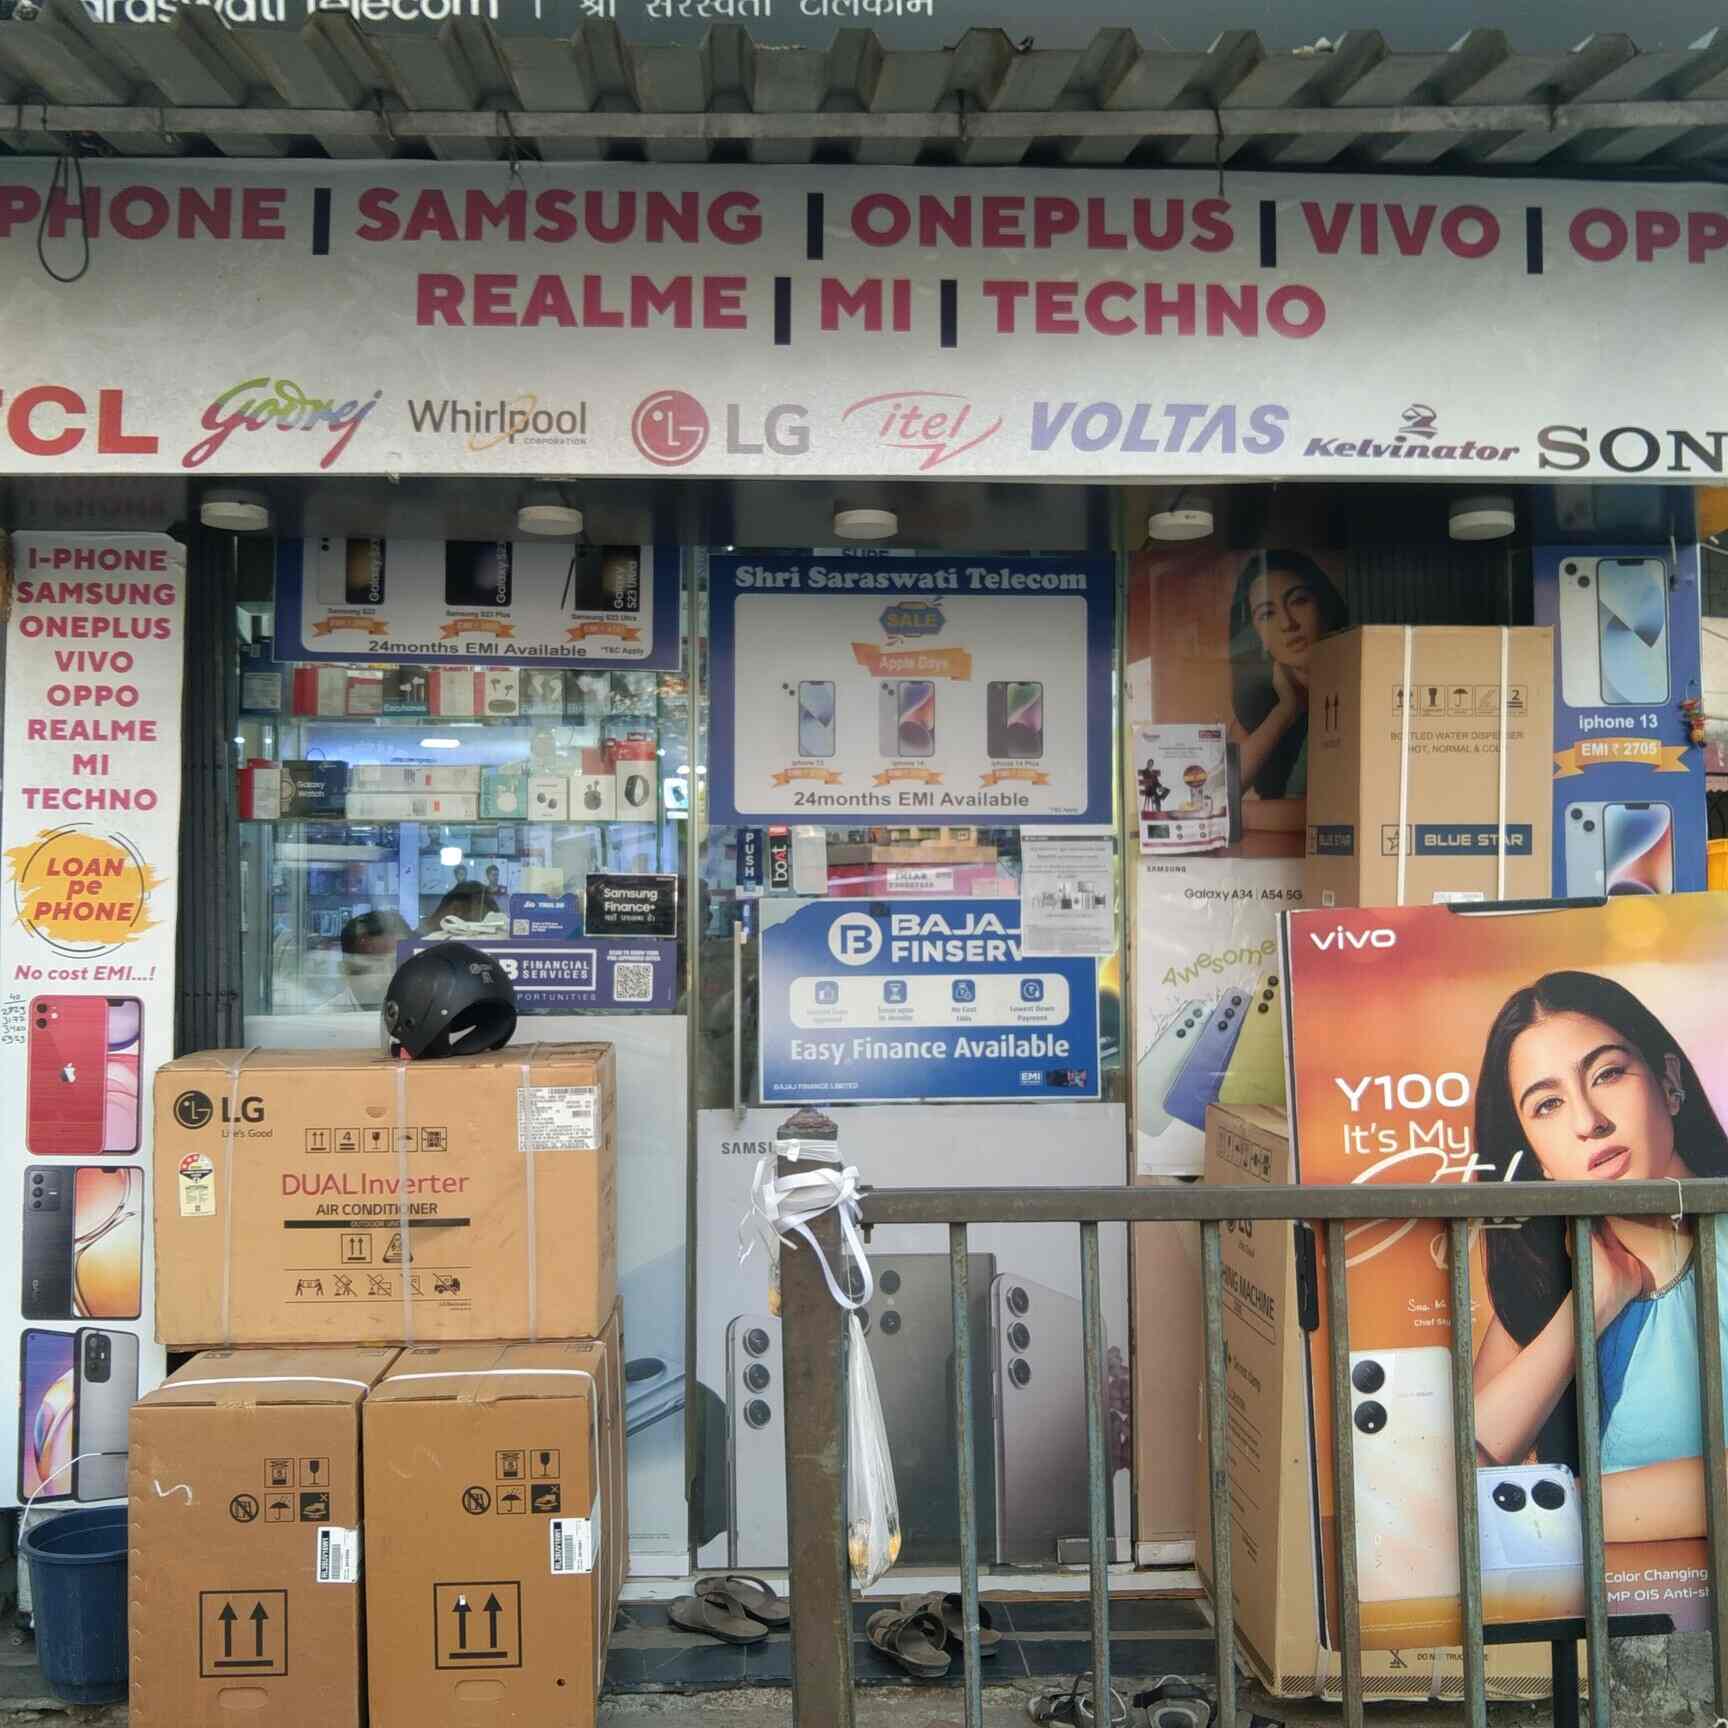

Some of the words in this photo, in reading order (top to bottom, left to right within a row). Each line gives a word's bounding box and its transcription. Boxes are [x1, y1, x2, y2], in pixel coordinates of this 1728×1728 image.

[355, 189, 762, 245] SAMSUNG
[851, 192, 1235, 253] ONEPLUS
[1301, 203, 1500, 259] VIVO
[416, 273, 748, 329] REALME
[820, 278, 911, 332] MI
[982, 280, 1326, 339] TECHNO
[0, 385, 159, 456] CL
[181, 377, 383, 468] Godrej
[407, 400, 587, 443] Whirlpool
[726, 402, 810, 455] LG
[879, 403, 971, 440] itel
[1030, 401, 1290, 455] VOLTAS
[1302, 437, 1520, 462] Kelvinator
[28, 547, 168, 571] I-PHONE
[496, 558, 509, 604] Galaxy
[735, 565, 801, 589] Shri
[807, 565, 958, 590] Saraswati
[965, 568, 1088, 591] Telecom
[16, 581, 176, 606] SAMSUNG
[19, 615, 171, 640] ONEPLUS
[369, 639, 459, 654] 24months
[466, 641, 499, 655] EMI
[504, 642, 587, 657] Available
[54, 650, 134, 674] VIVO
[47, 684, 140, 708] OPPO
[27, 719, 157, 741] REALME
[1578, 714, 1634, 732] iphone
[1640, 714, 1658, 729] 13
[1390, 731, 1434, 741] BOTLED
[1435, 731, 1469, 740] WATER
[1432, 744, 1470, 753] NORMAL
[1481, 744, 1504, 753] COL
[1582, 742, 1608, 757] EMI
[72, 754, 110, 775] MI
[22, 788, 158, 811] TECHNO
[794, 791, 891, 807] 24months
[898, 792, 934, 807] EMI
[940, 791, 1030, 808] Available
[1424, 833, 1472, 847] BLUE
[744, 832, 755, 877] PUSH
[46, 857, 125, 877] LOAN
[1147, 865, 1187, 873] SAMSUNG
[66, 879, 104, 901] pe
[604, 887, 658, 901] Samsung
[1184, 887, 1230, 901] Galaxy
[1231, 888, 1253, 900] A34
[1260, 888, 1283, 901] A54
[1285, 889, 1303, 901] 5G
[33, 902, 136, 921] PHONE
[1310, 926, 1397, 951] vivo
[14, 964, 43, 981] No
[48, 965, 89, 981] cost
[522, 960, 590, 970] FINANCIAL
[522, 970, 588, 979] SERVICES
[1162, 938, 1277, 988] Awesome
[790, 1038, 845, 1065] Easy
[852, 1036, 946, 1059] Finance
[954, 1033, 1070, 1059] Available
[1020, 1071, 1041, 1081] EMI
[1335, 1071, 1470, 1112] Y100
[221, 1096, 265, 1123] LG
[221, 1129, 246, 1138] Lie's
[247, 1129, 273, 1138] Good
[1343, 1122, 1398, 1155] It's
[1408, 1118, 1470, 1159] My
[721, 1141, 773, 1155] SAMS
[281, 1173, 361, 1196] DUAL
[361, 1172, 470, 1195] Inverter
[315, 1203, 340, 1216] AIR
[1238, 1276, 1276, 1321] MACHINE
[1604, 1570, 1641, 1583] Color
[1643, 1568, 1709, 1583] Changing
[1607, 1590, 1631, 1603] MP
[1634, 1588, 1660, 1601] OIS
